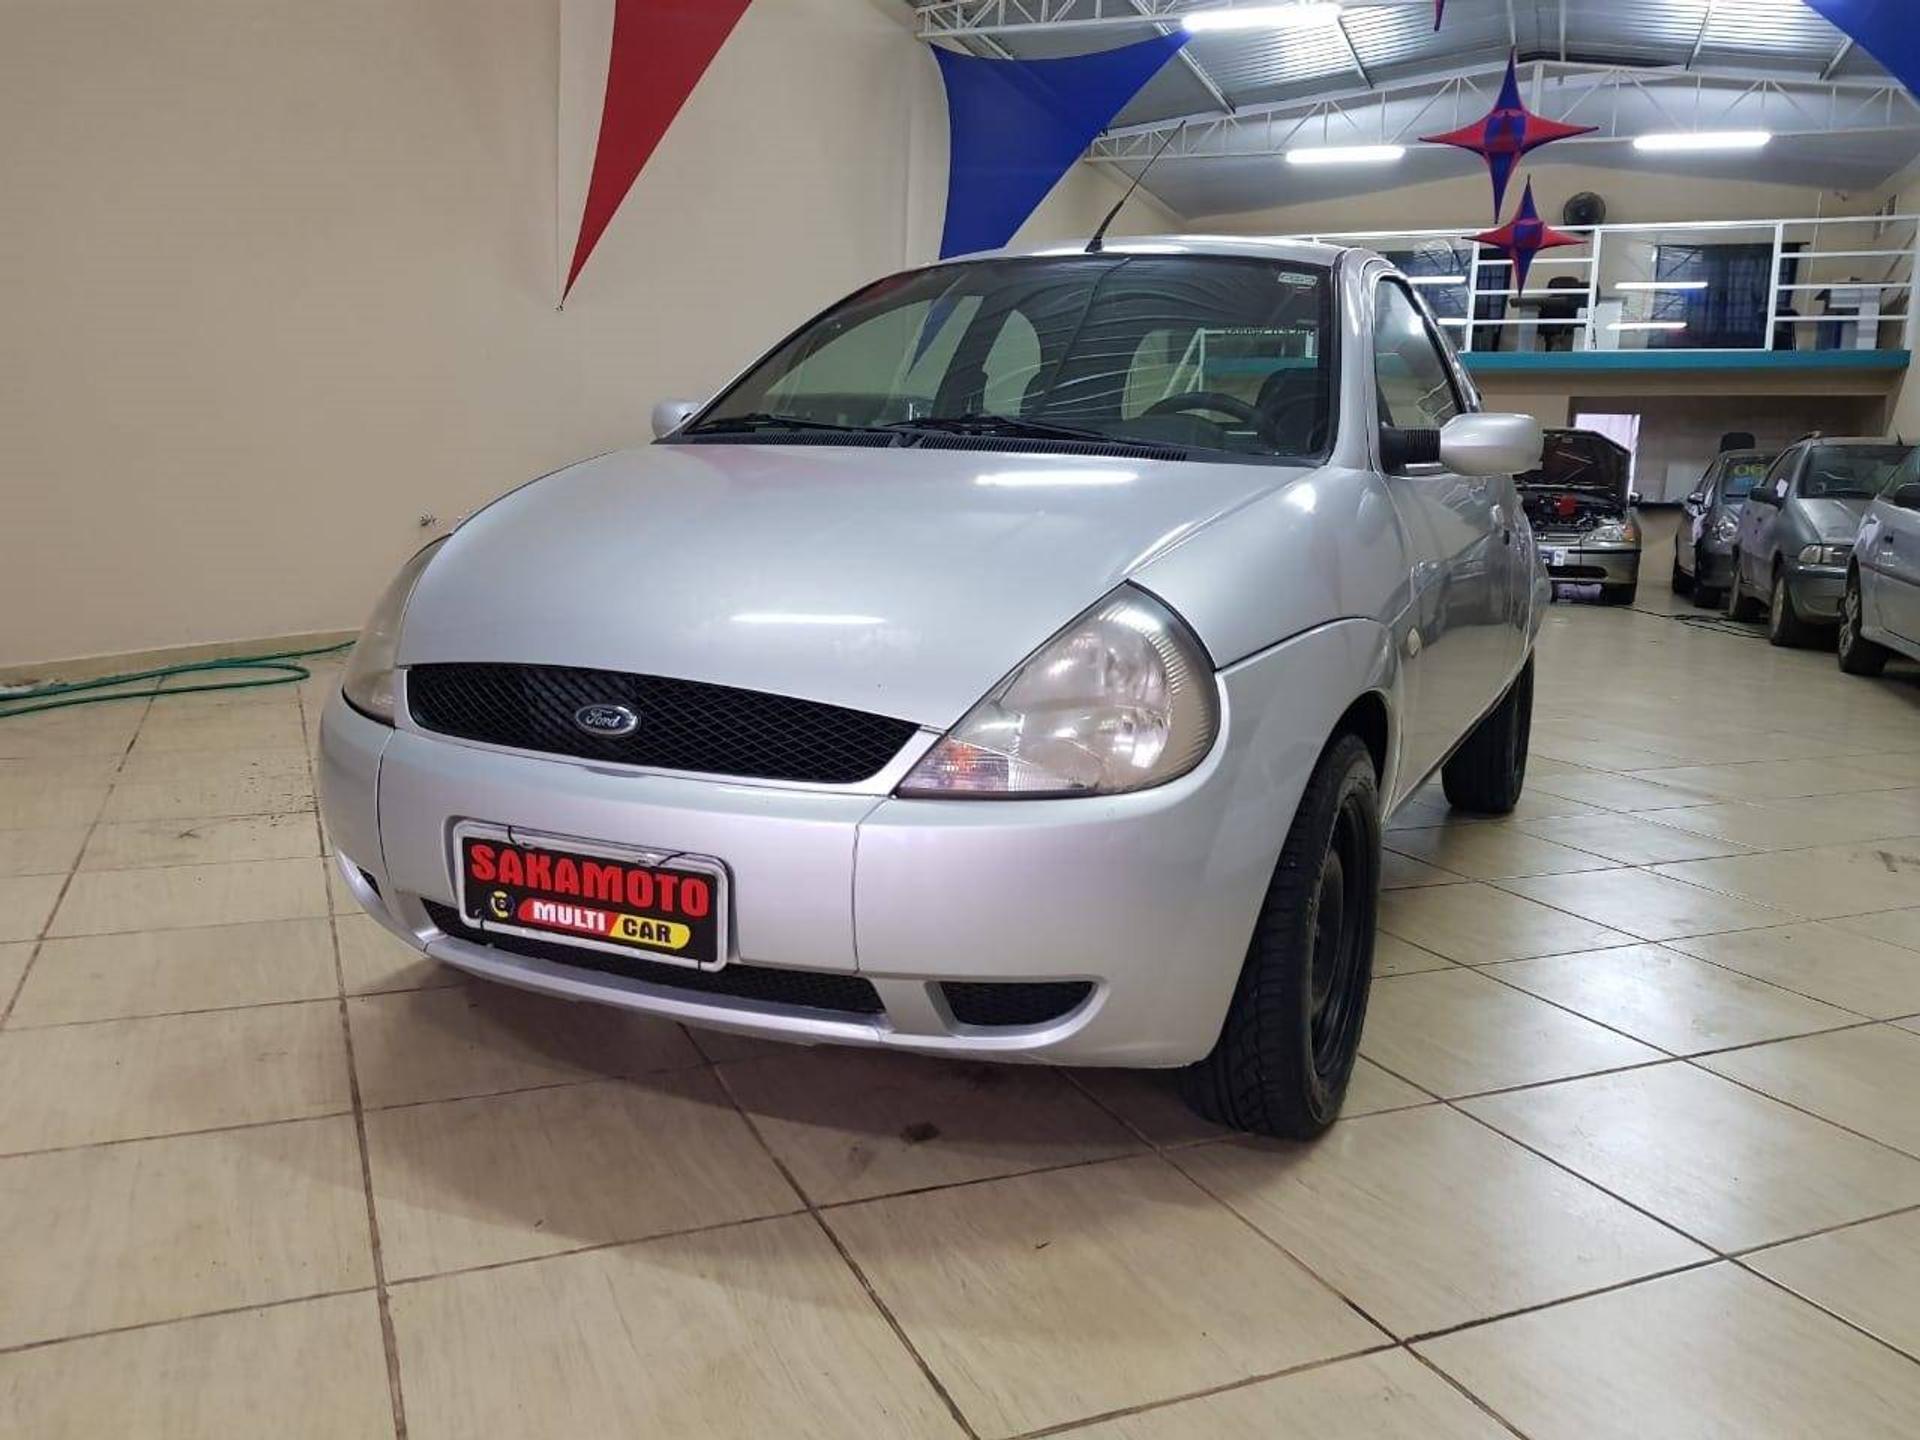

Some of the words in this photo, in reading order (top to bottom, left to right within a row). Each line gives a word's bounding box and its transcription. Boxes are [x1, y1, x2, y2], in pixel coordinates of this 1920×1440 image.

[586, 708, 622, 728] Ford
[471, 845, 709, 917] SAKAMOTO
[533, 900, 606, 932] MULTI
[623, 917, 672, 944] CAR
